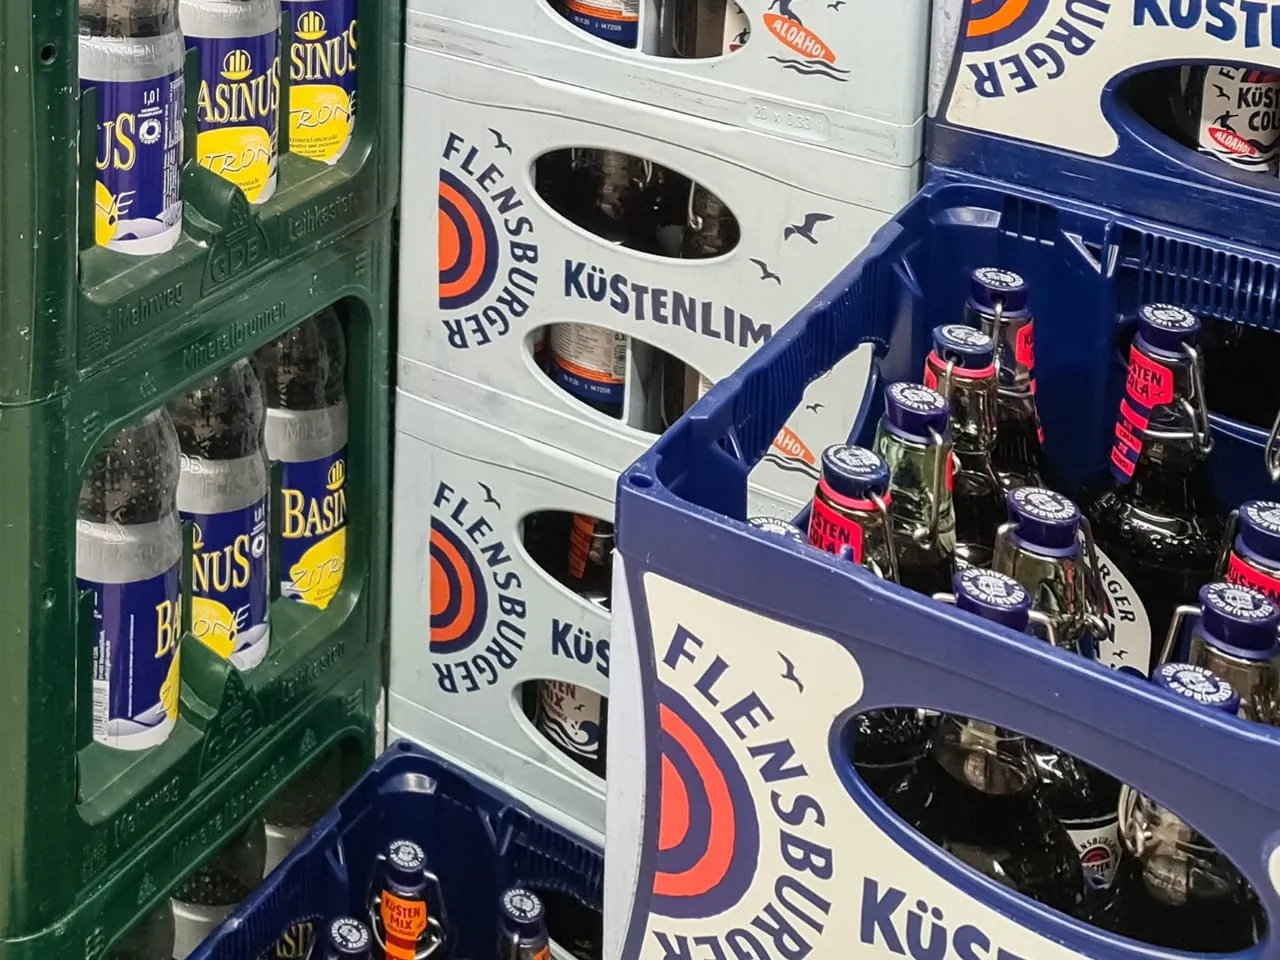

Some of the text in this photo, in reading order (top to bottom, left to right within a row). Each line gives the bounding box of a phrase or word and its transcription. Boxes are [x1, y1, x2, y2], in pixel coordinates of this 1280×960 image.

[289, 18, 358, 81] SINUS
[197, 56, 279, 124] ASINUS
[442, 131, 539, 350] FLENSBURGER
[182, 299, 287, 371] Mineralbrunnen
[564, 258, 773, 348] KÜSTENLIM
[432, 480, 527, 694] FLENSBURGER
[390, 914, 413, 930] MIX
